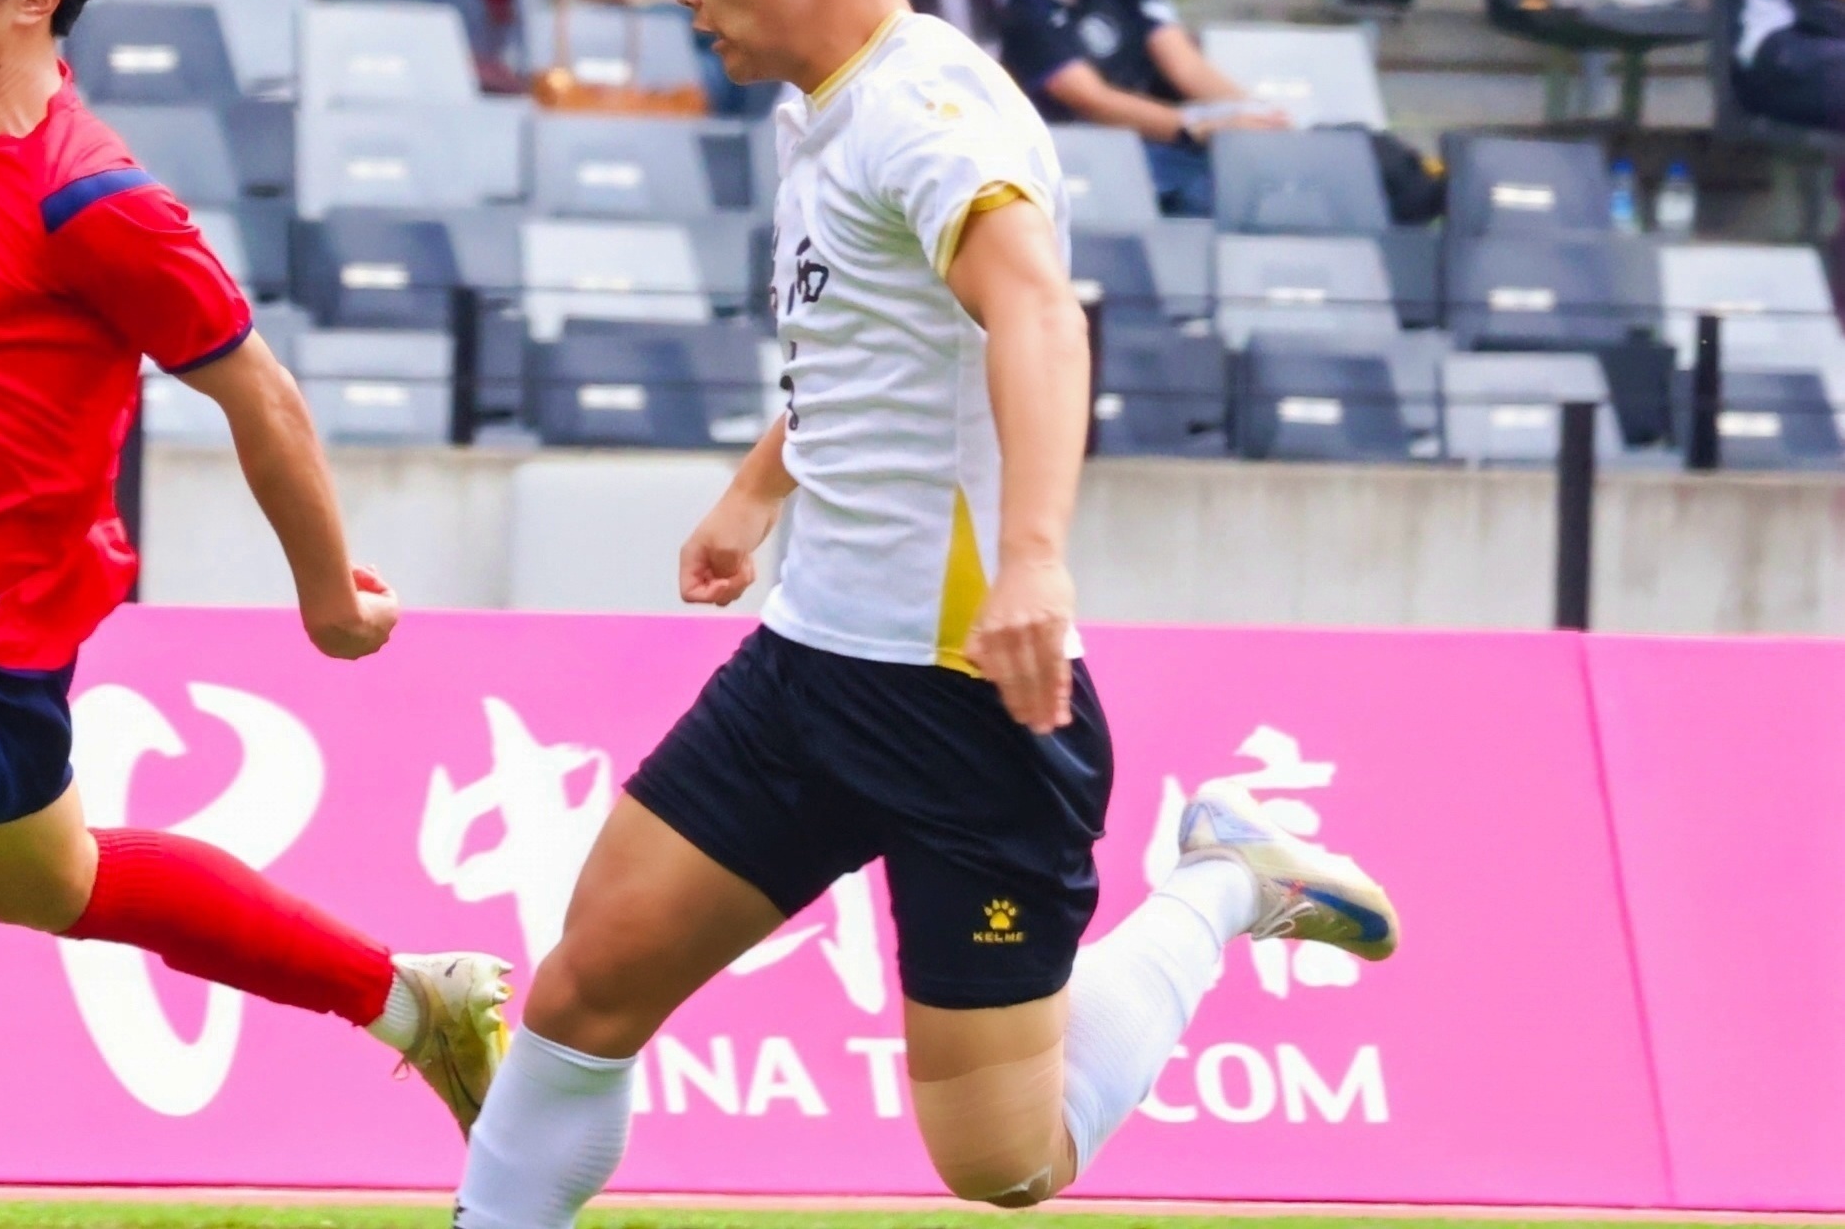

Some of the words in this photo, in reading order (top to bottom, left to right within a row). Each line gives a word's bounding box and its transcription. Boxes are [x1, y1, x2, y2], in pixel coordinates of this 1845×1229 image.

[972, 931, 1024, 944] KELME
[631, 1035, 830, 1116] INA
[845, 1036, 1391, 1124] TCOM
